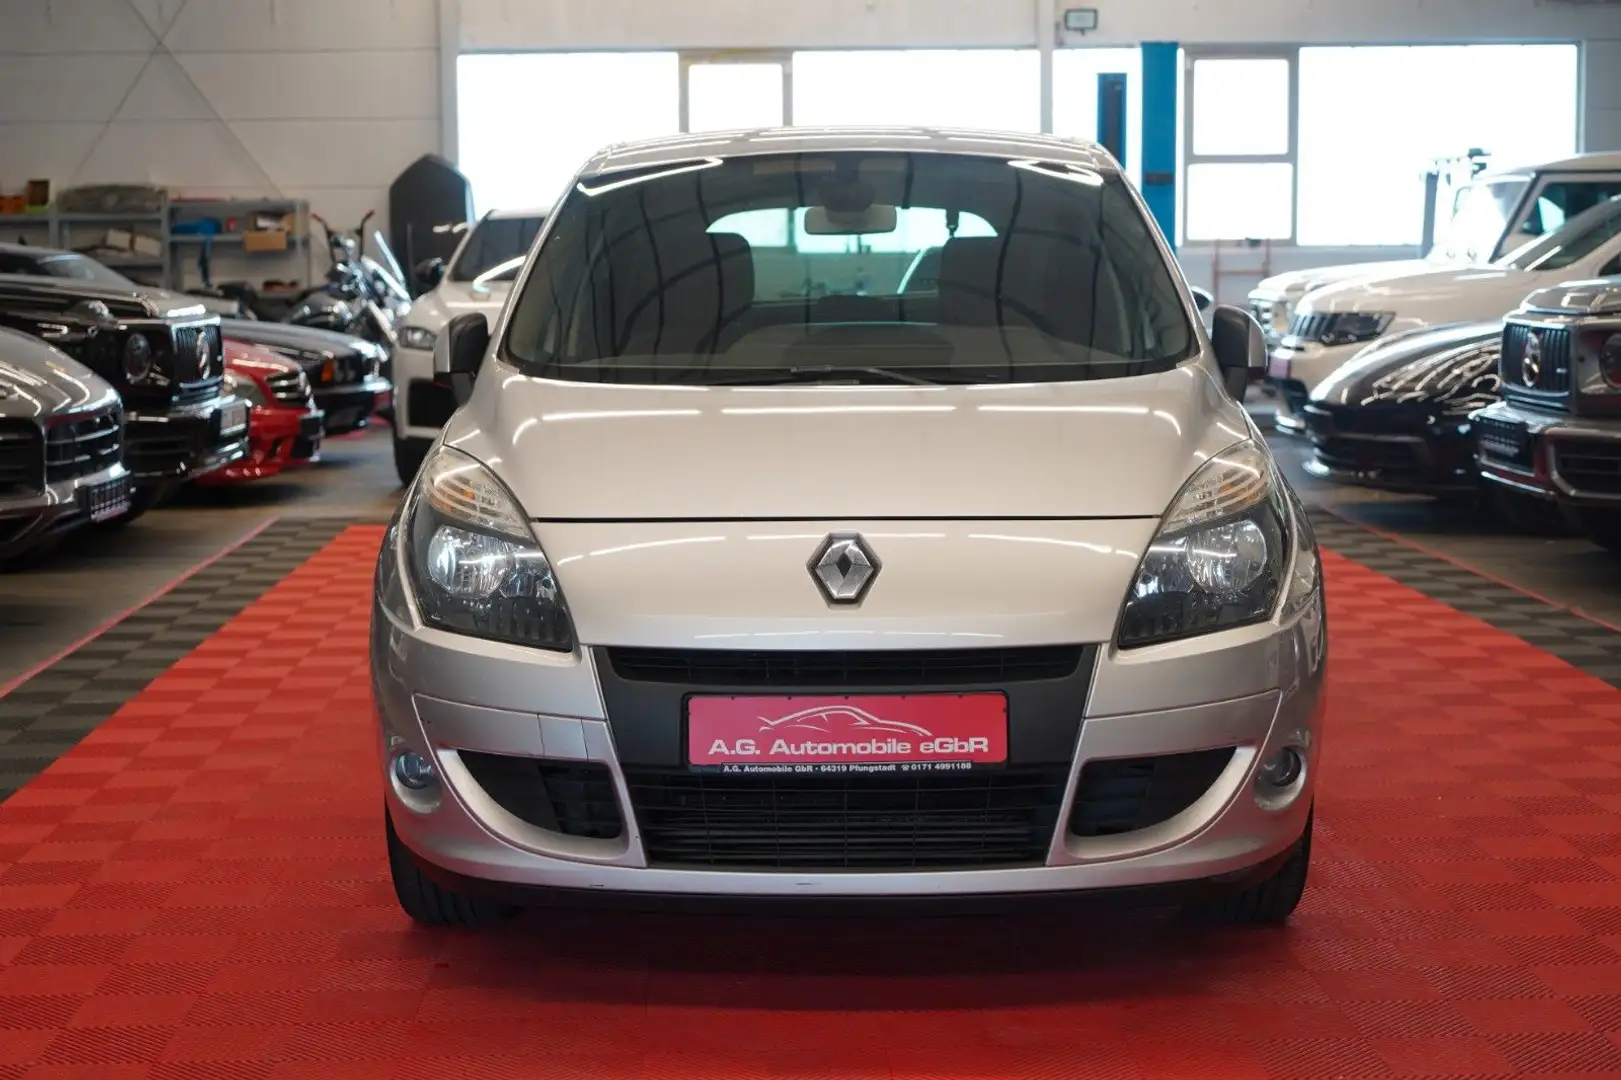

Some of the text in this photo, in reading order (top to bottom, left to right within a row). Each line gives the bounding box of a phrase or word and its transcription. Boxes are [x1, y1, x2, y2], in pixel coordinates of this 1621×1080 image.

[708, 737, 988, 755] A.G. Automobile eGbR
[723, 764, 742, 773] A.G.
[743, 764, 793, 773] Automobile
[794, 764, 813, 773] GbR
[820, 764, 847, 772] 64319
[848, 763, 897, 773] Pfungstadt
[910, 763, 932, 771] 0171
